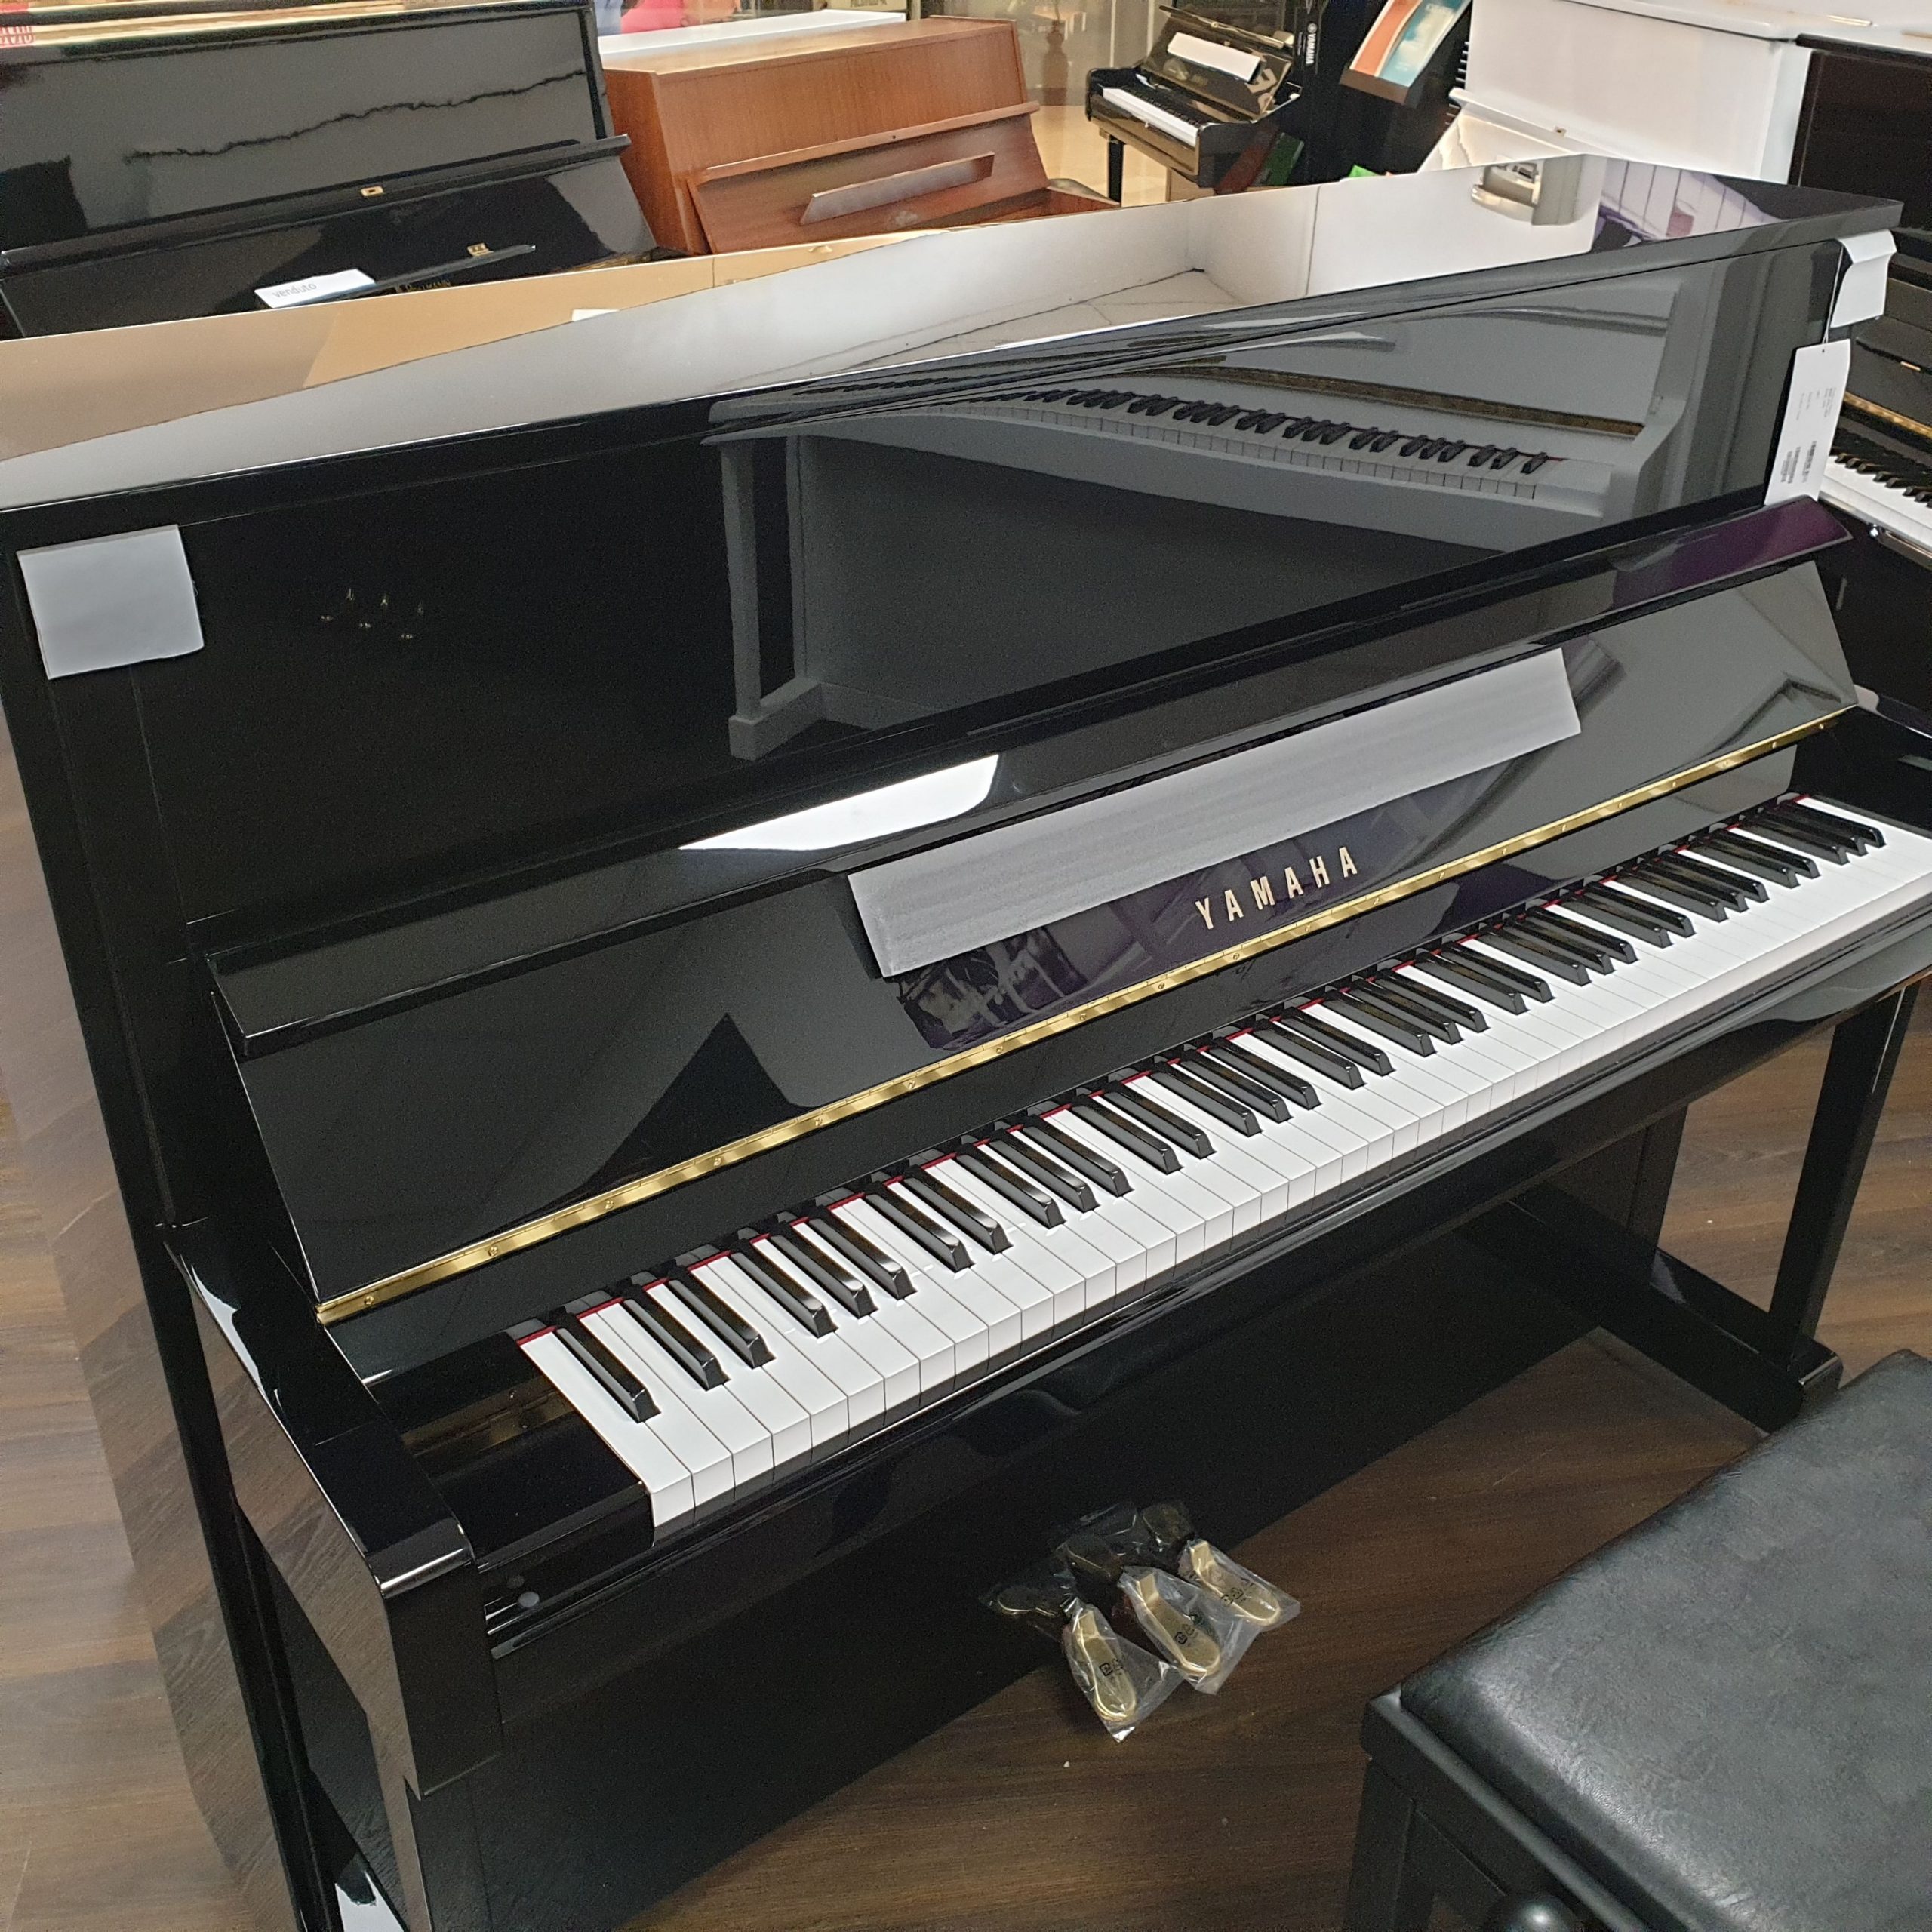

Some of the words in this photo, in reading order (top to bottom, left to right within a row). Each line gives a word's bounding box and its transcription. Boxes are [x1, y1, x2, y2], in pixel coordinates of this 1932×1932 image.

[1306, 33, 1316, 64] YAMAHA
[272, 282, 317, 298] venduto
[1195, 846, 1358, 929] YAMAHA
